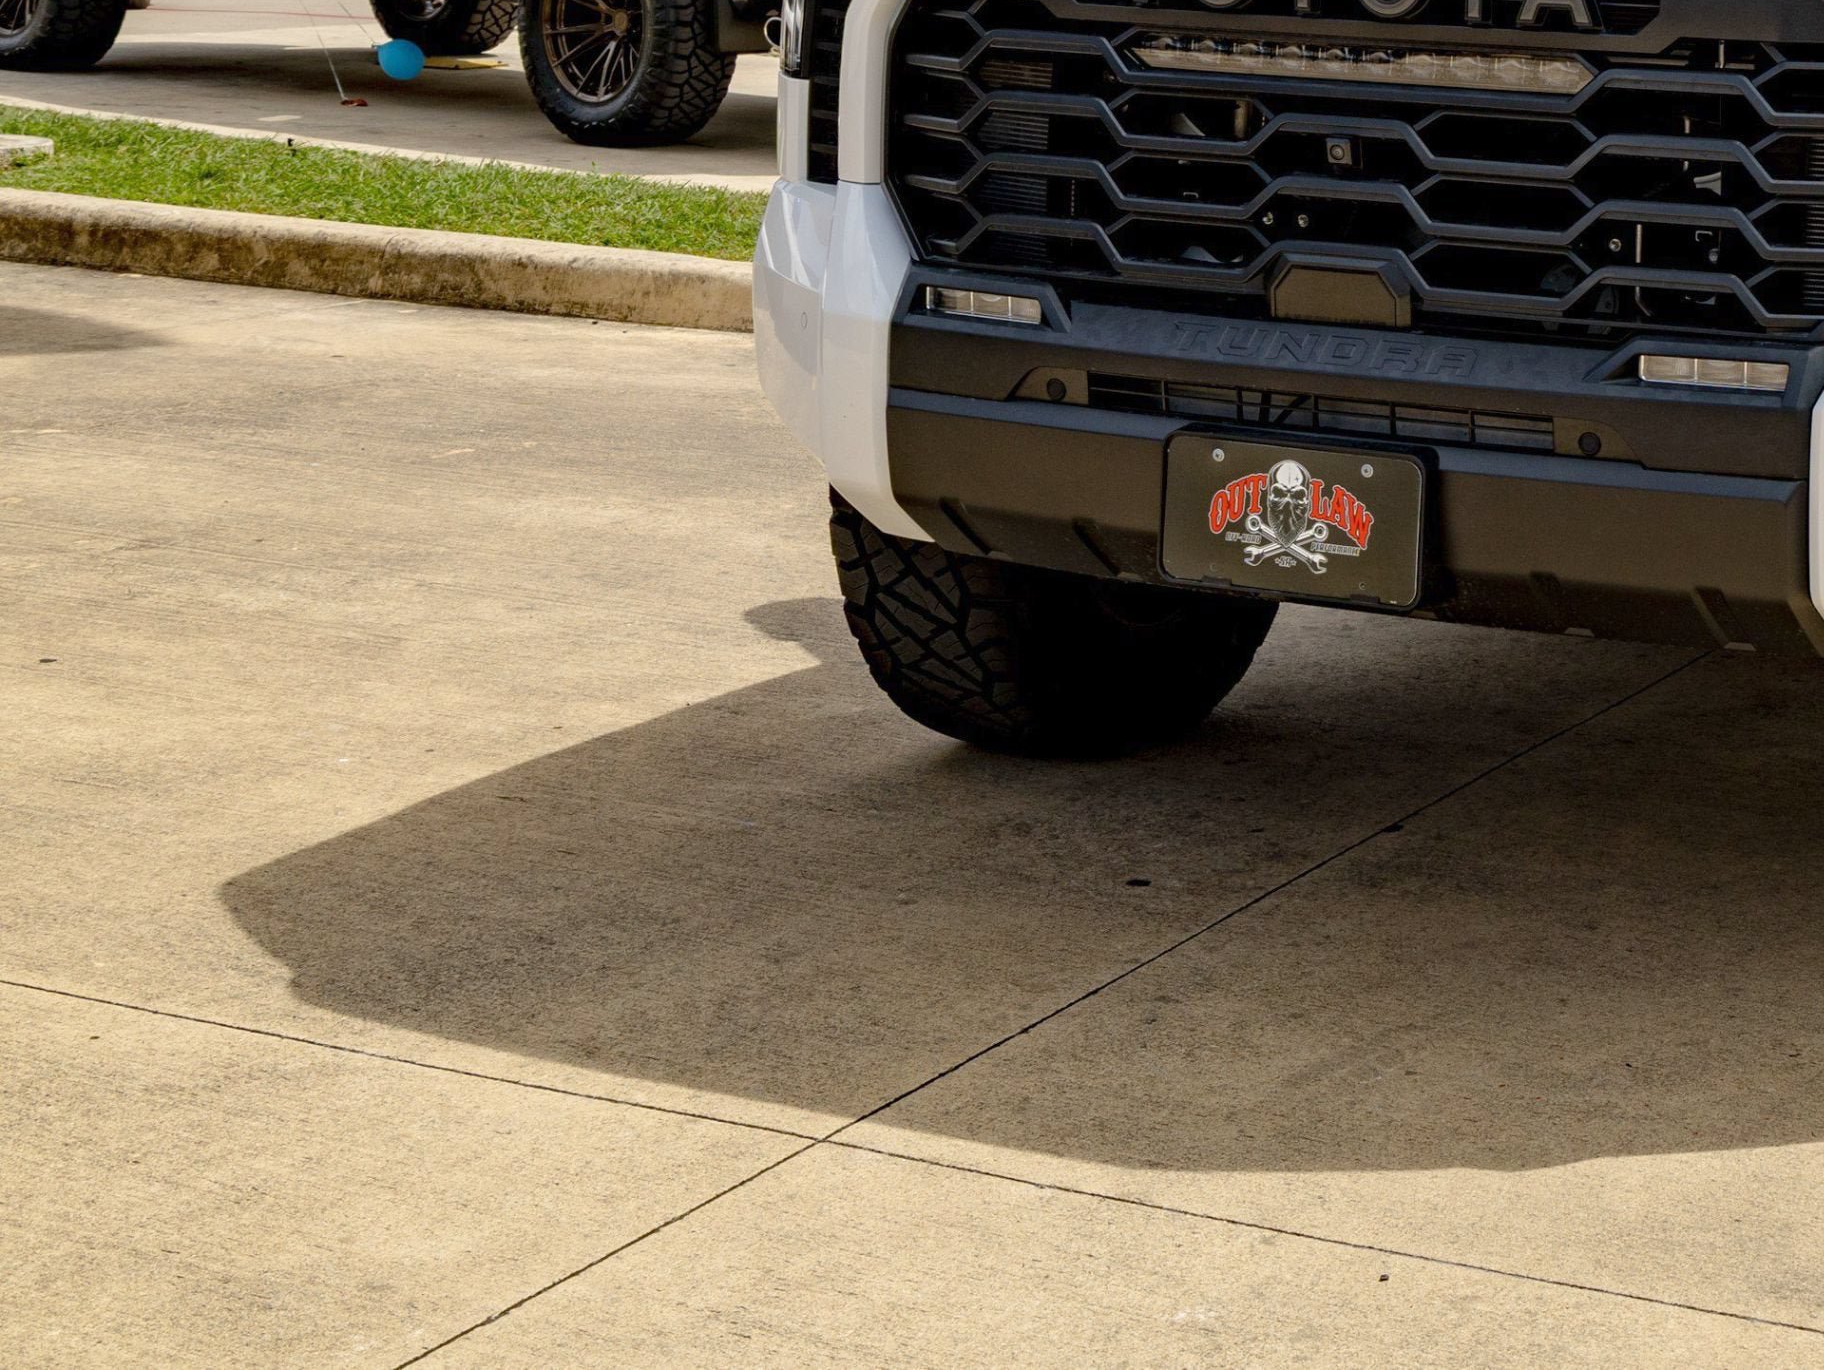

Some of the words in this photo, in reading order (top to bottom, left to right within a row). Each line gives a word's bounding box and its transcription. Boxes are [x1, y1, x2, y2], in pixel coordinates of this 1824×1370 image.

[1174, 320, 1480, 378] TUNDRA
[1208, 473, 1268, 534] OUT
[1309, 479, 1374, 550] LAW
[1310, 542, 1361, 557] PERFORMANCE
